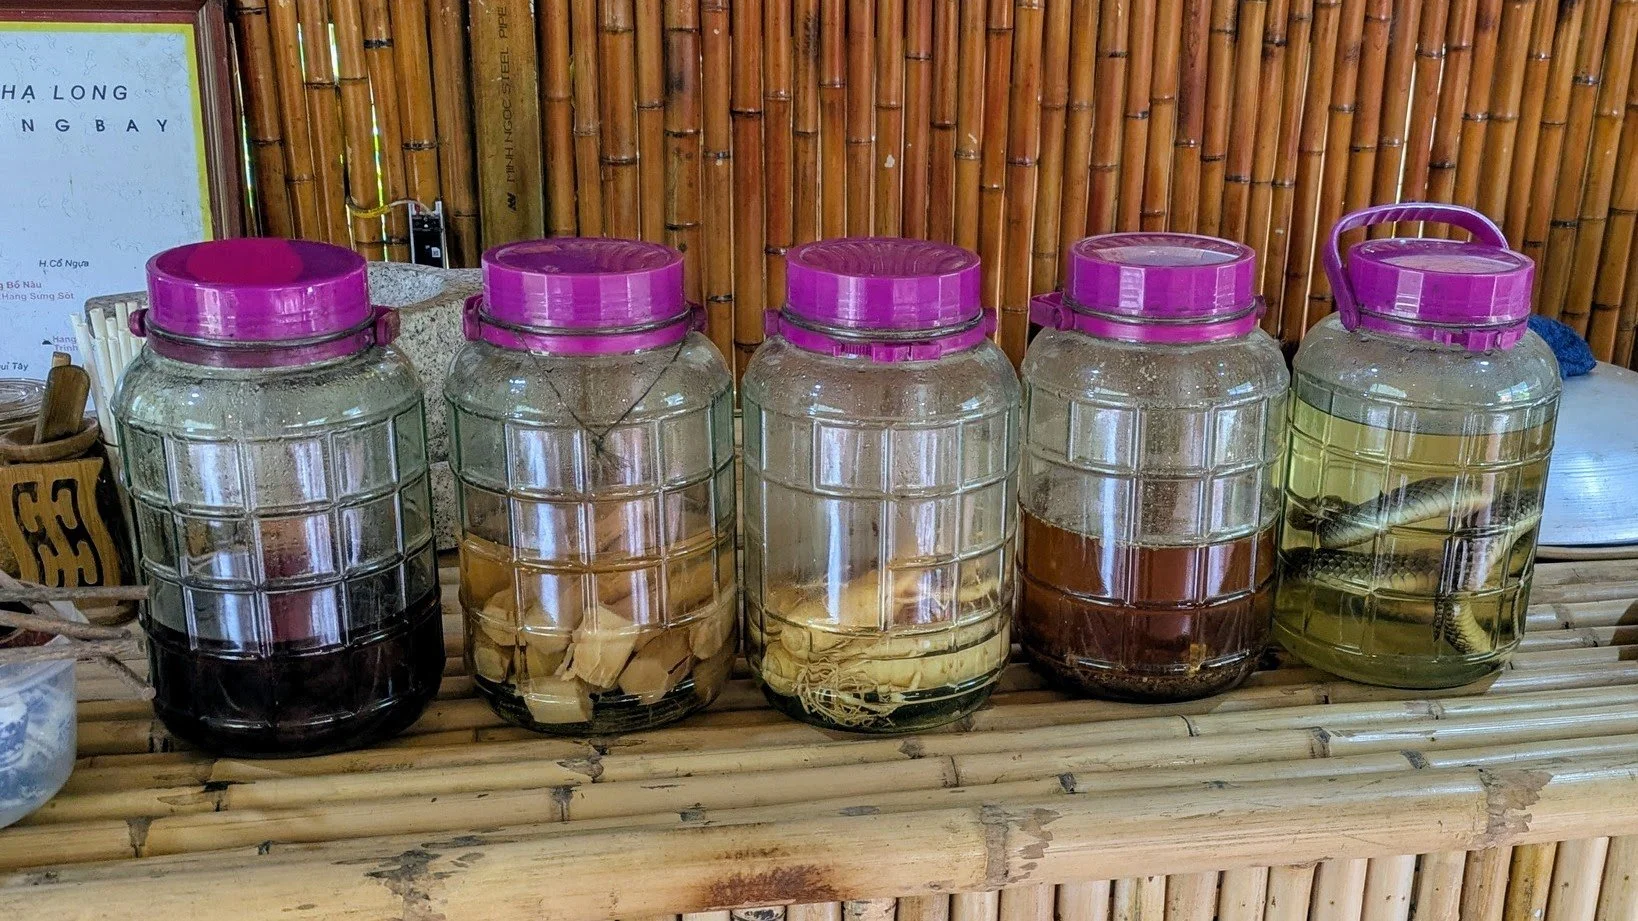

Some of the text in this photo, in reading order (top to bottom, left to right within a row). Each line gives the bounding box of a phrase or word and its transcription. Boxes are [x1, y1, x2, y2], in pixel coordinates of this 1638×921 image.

[496, 6, 508, 39] PIPE
[499, 47, 511, 95] STEEL
[1, 84, 128, 103] HẠ LONG
[505, 146, 516, 183] MINH
[2, 292, 27, 302] Hang
[12, 362, 29, 372] Tây
